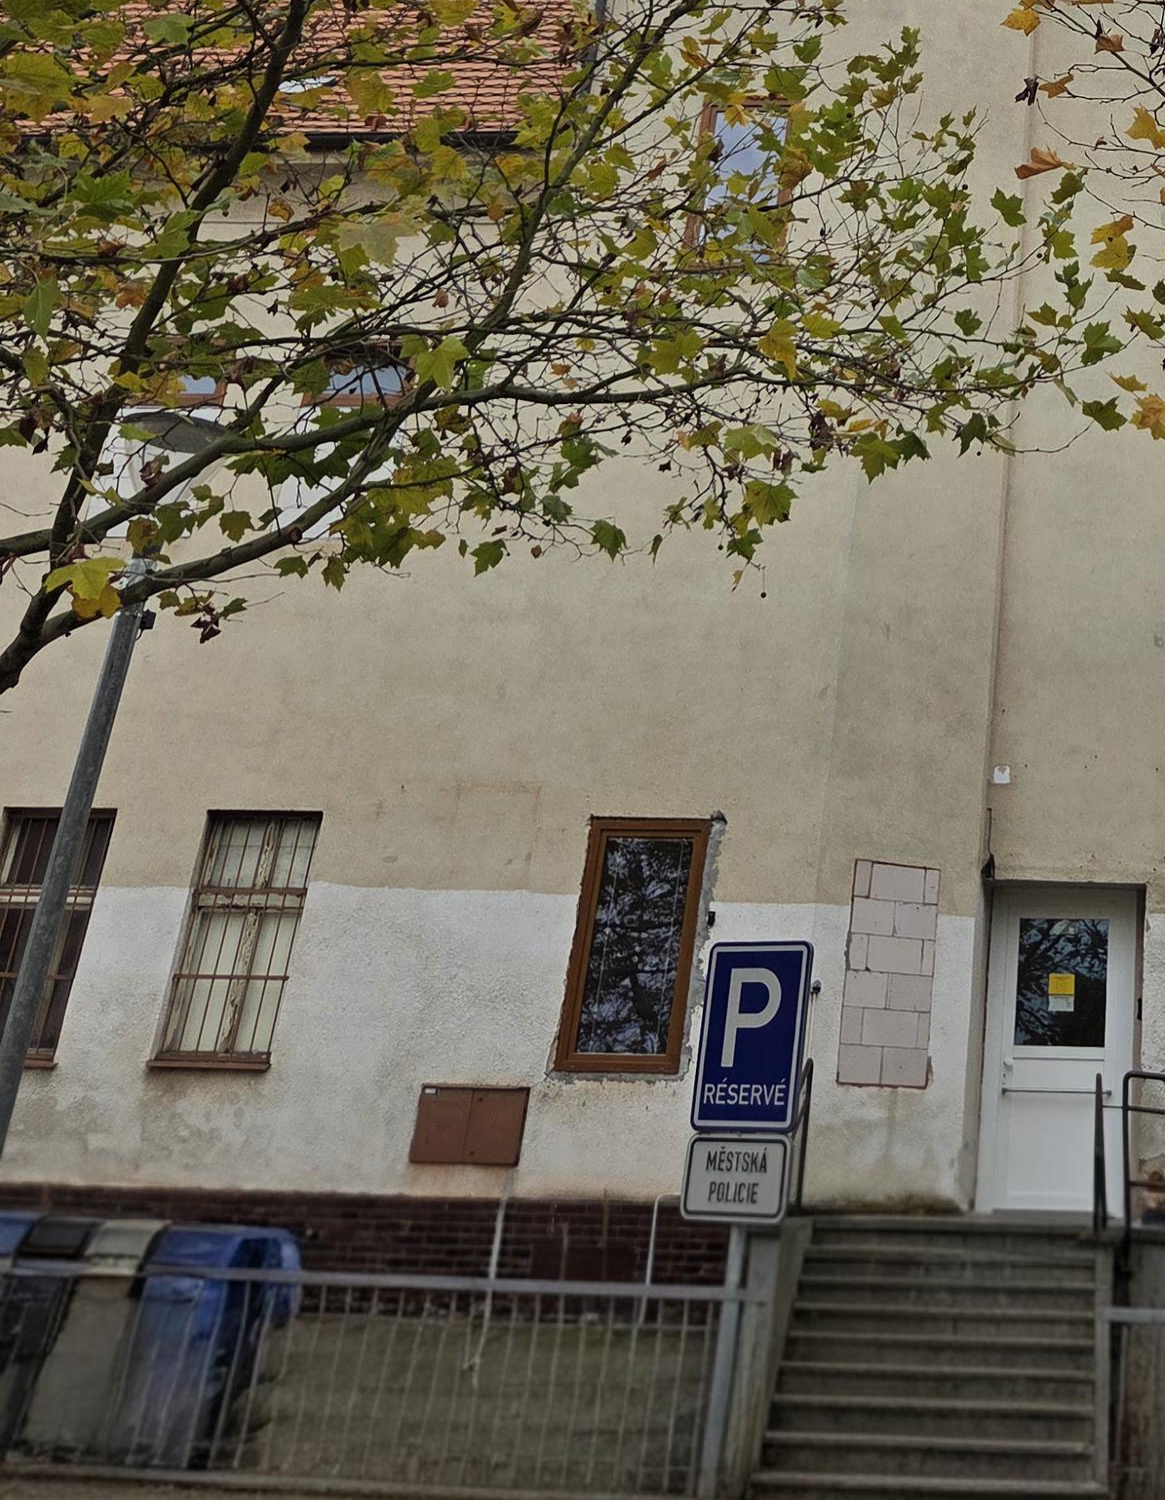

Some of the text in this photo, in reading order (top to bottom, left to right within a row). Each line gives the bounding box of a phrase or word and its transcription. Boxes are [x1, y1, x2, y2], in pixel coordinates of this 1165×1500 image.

[720, 968, 782, 1067] P
[703, 1077, 787, 1106] RÉSERVÉ
[705, 1146, 767, 1173] MĚSTSKÁ
[708, 1181, 759, 1204] POLICIE
